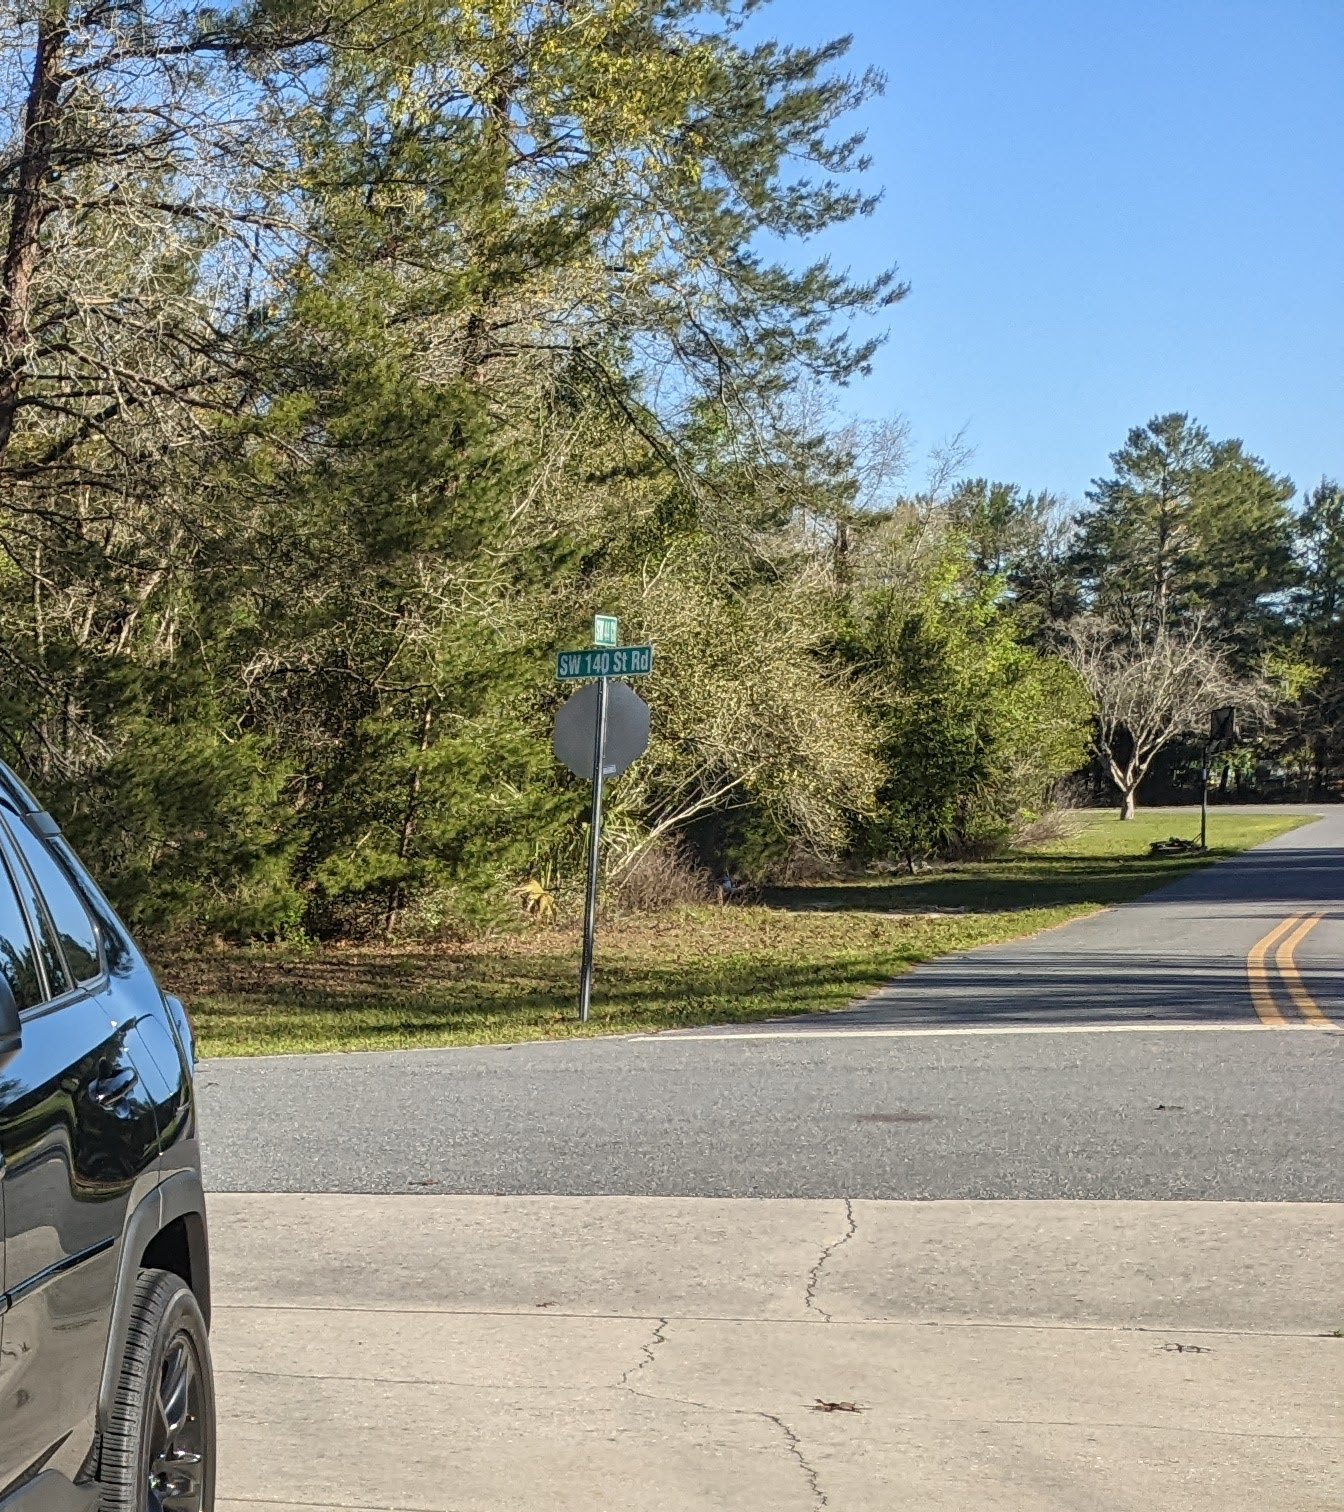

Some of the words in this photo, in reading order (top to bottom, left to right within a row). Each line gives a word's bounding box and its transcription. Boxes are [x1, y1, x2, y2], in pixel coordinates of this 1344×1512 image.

[559, 654, 582, 676] SW
[585, 652, 610, 675] 140
[613, 651, 628, 672] St
[631, 650, 649, 671] Rd
